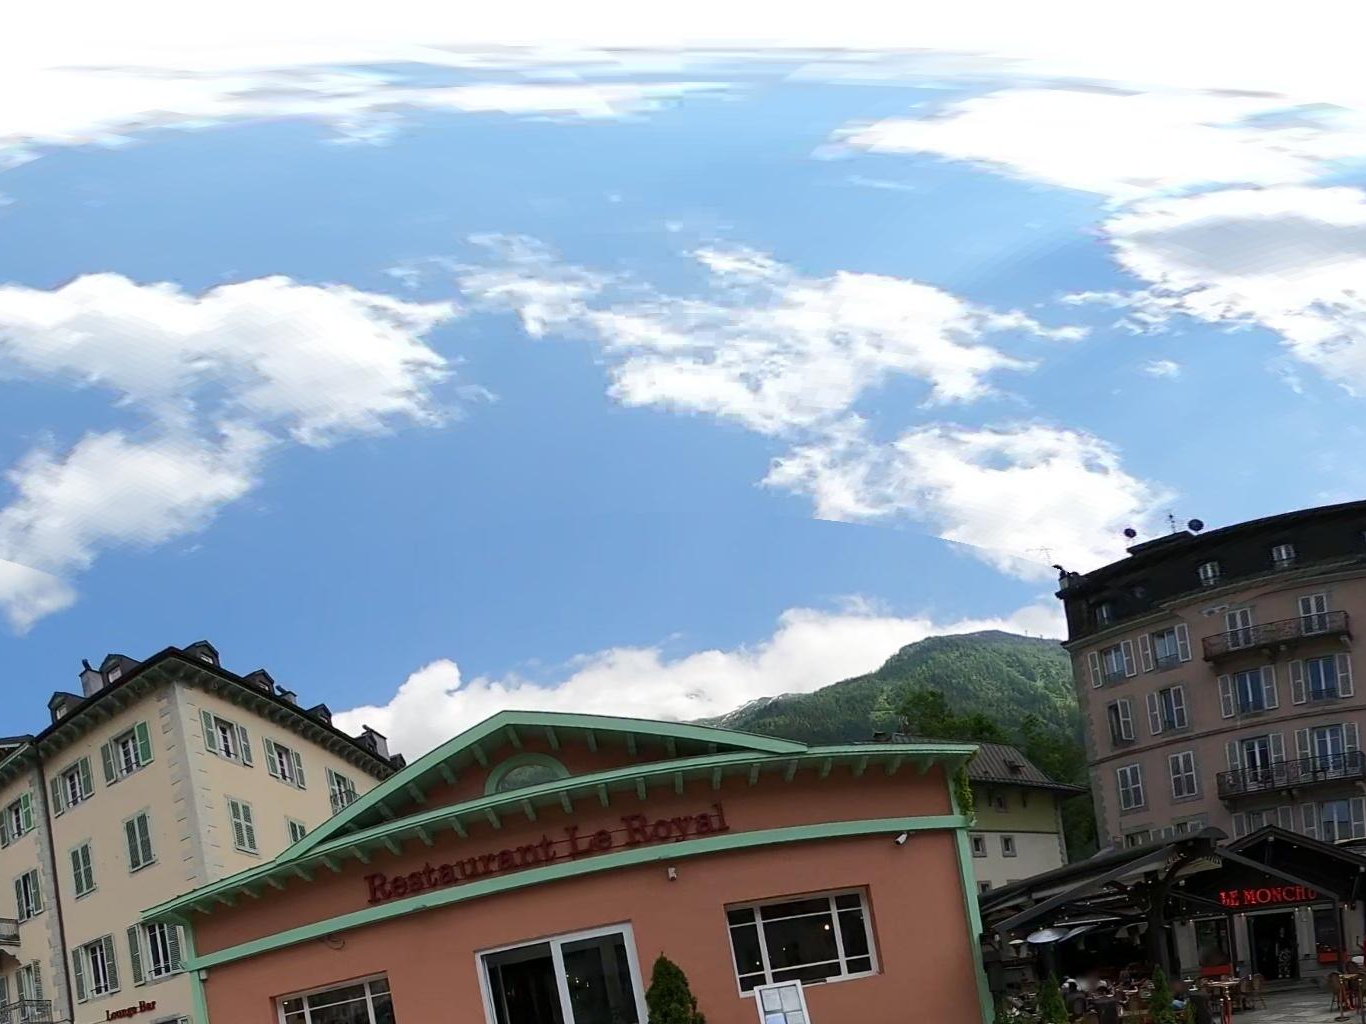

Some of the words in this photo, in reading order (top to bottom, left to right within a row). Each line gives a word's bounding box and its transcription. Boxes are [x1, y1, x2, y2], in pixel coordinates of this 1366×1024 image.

[366, 833, 557, 903] Restaurant
[563, 825, 614, 861] Le
[620, 799, 731, 845] Royal
[106, 1007, 138, 1021] Lounge
[138, 1000, 156, 1013] Bar
